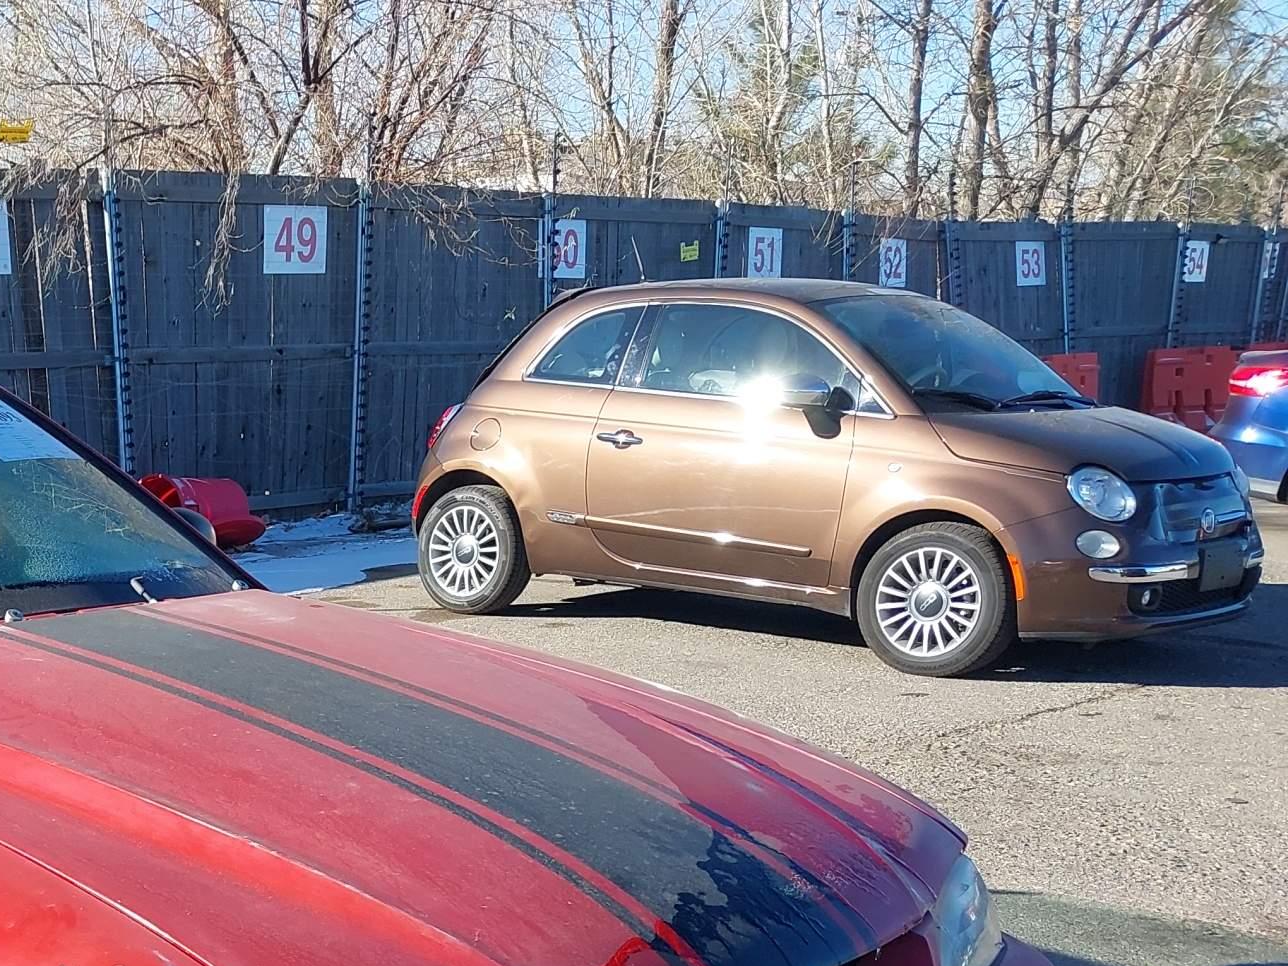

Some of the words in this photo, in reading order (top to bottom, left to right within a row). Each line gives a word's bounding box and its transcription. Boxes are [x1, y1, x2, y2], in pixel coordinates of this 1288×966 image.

[274, 216, 317, 263] 49
[753, 236, 775, 273] 51
[884, 246, 902, 279] 52
[1021, 248, 1041, 279] 53
[1187, 247, 1205, 276] 54
